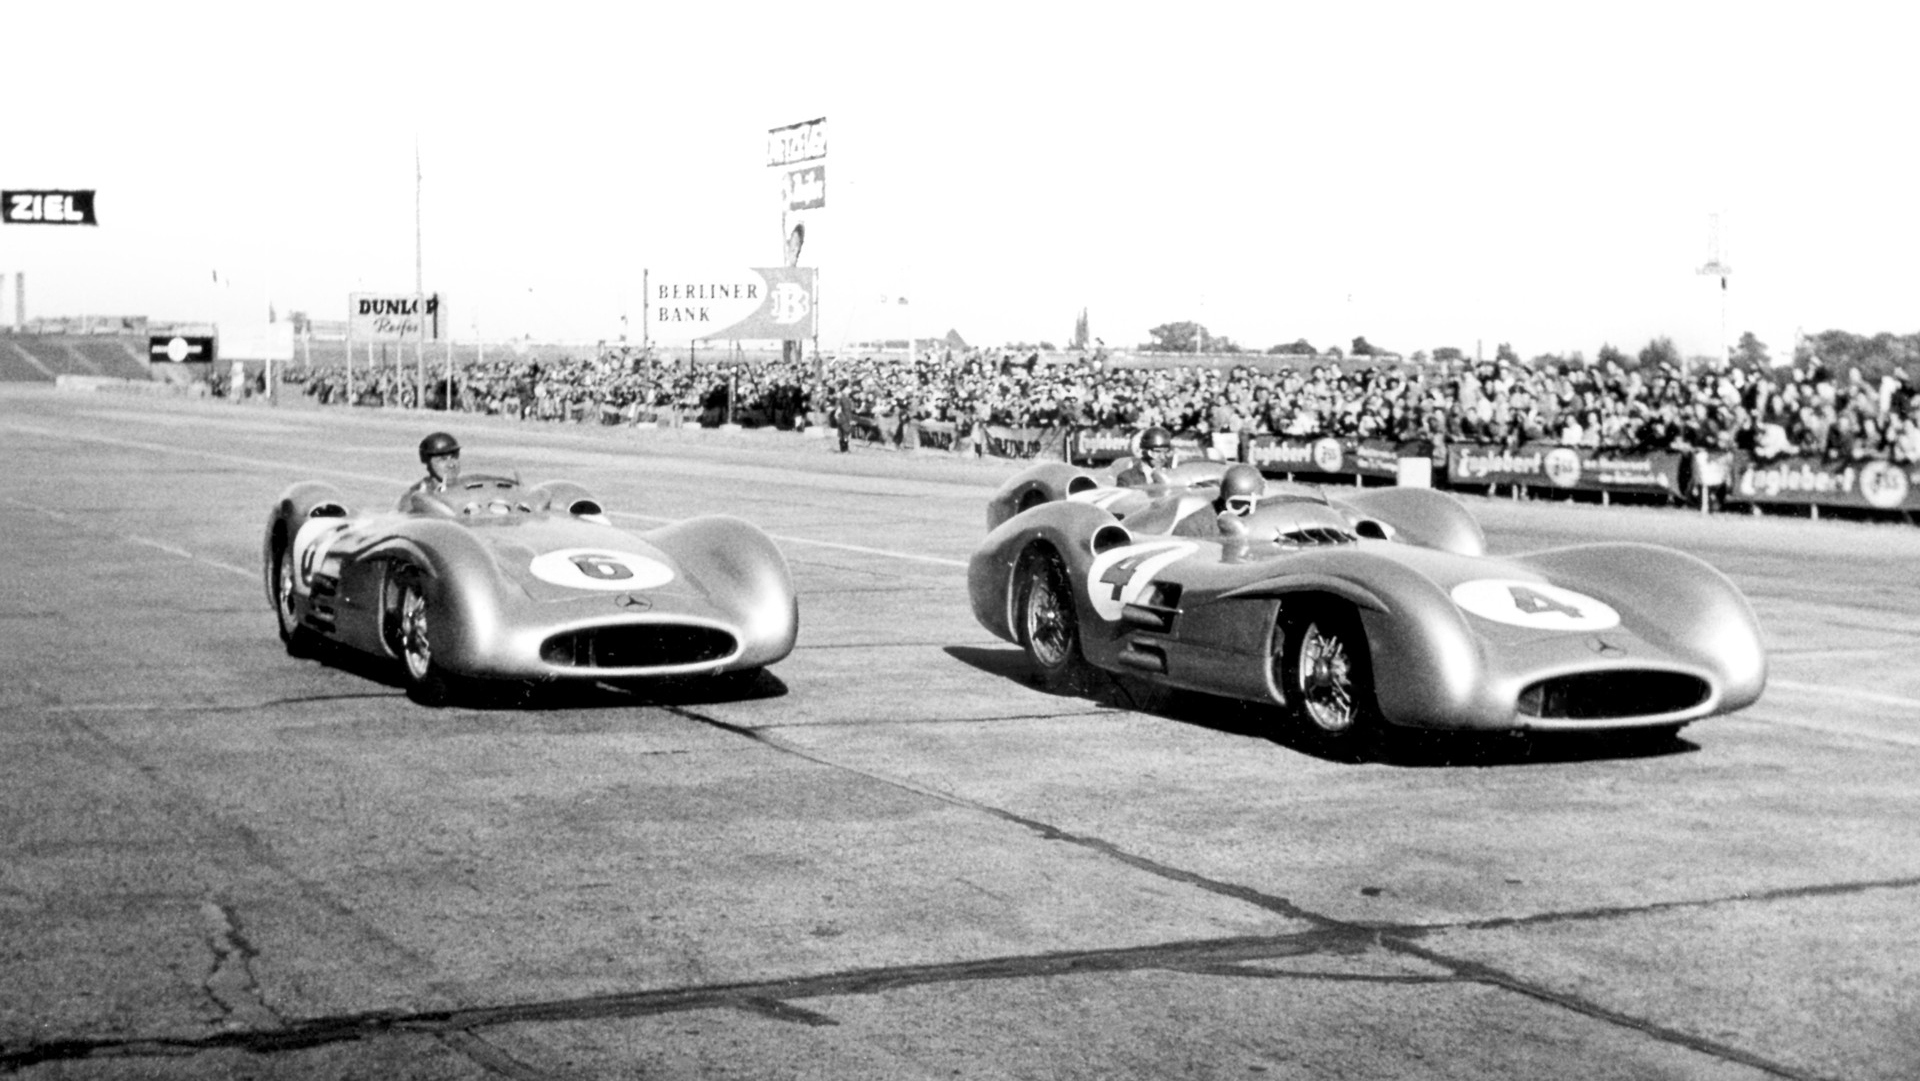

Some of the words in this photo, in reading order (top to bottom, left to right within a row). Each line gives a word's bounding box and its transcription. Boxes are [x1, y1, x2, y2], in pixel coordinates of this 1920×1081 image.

[10, 194, 84, 222] ZIEL
[658, 284, 758, 299] BERLINER
[658, 307, 710, 322] BANK
[568, 554, 634, 580] 6
[1099, 546, 1180, 601] 4
[1507, 587, 1586, 618] 4
